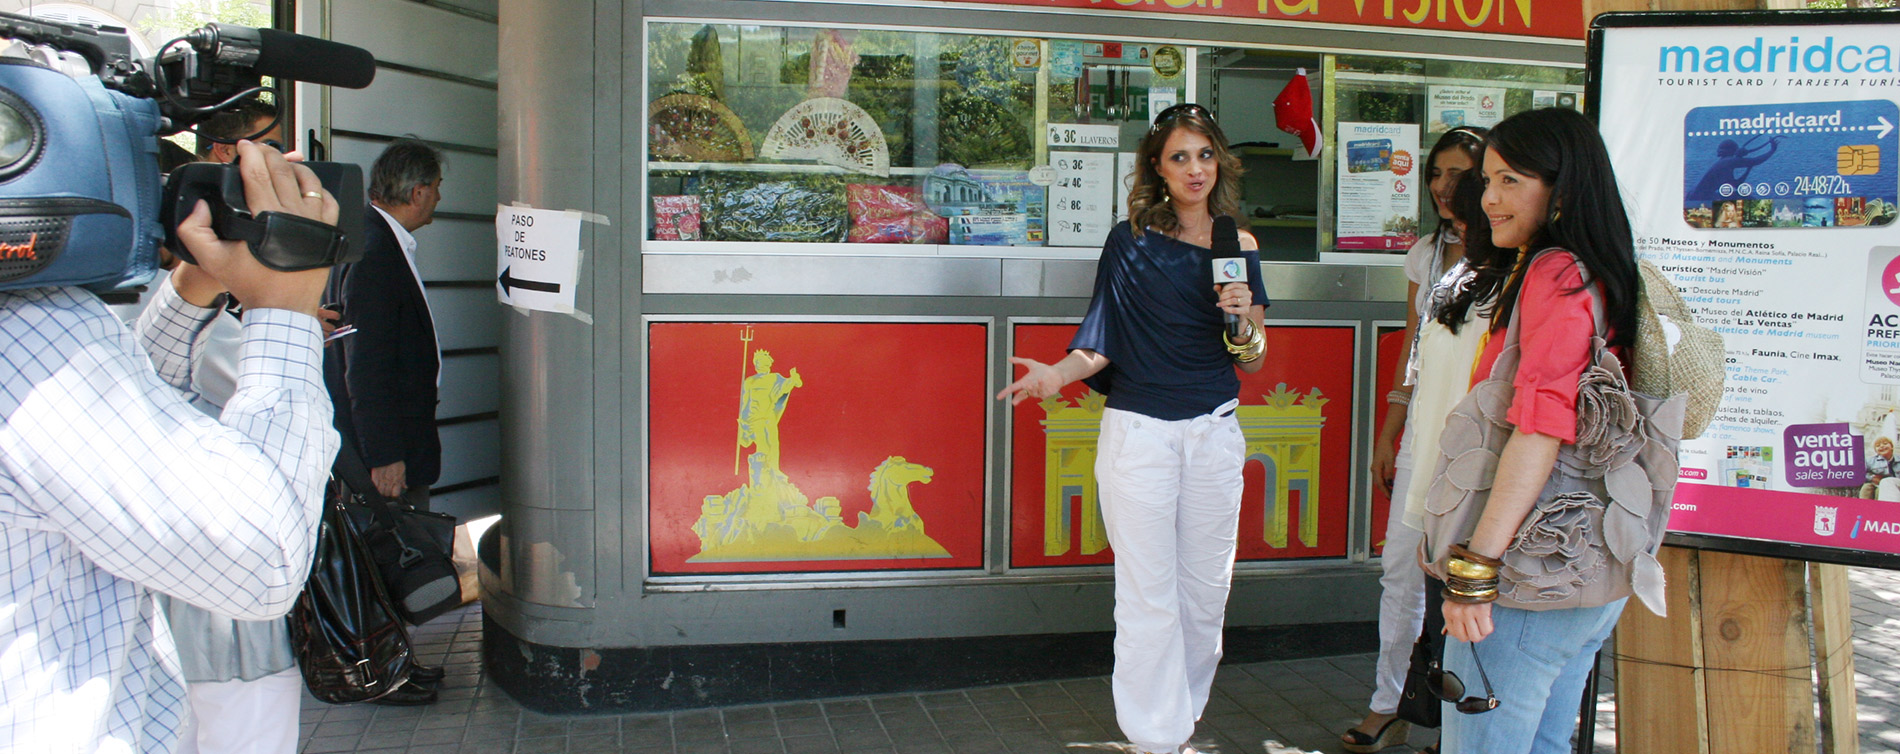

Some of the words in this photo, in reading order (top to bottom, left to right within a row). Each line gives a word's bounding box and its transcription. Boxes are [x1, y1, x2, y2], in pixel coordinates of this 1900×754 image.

[1658, 36, 1900, 73] madridca
[1658, 78, 1718, 86] TOURIST
[1726, 78, 1764, 86] CARD
[1787, 79, 1849, 87] TARJETA
[1719, 110, 1842, 130] madridcard
[1354, 125, 1401, 134] madridcard
[1080, 136, 1118, 145] LLAVEROS
[511, 214, 534, 227] PASO
[514, 230, 525, 242] DE
[1649, 237, 1659, 245] 50
[1661, 238, 1698, 246] Museos
[1708, 240, 1775, 249] Monumentos
[504, 245, 546, 261] PEATONES
[1672, 253, 1716, 262] Museums
[1735, 256, 1793, 265] Monuments
[1661, 265, 1704, 273] turístico
[1674, 273, 1706, 282] Tourist
[1709, 275, 1726, 283] bus
[1716, 297, 1742, 305] tours
[1701, 307, 1728, 316] Museo
[1746, 310, 1788, 319] Atlético
[1807, 312, 1844, 322] Madrid
[1696, 315, 1718, 324] Toros
[1721, 317, 1731, 325] de
[1868, 313, 1900, 328] AC
[1766, 329, 1804, 338] Madrid
[1805, 332, 1840, 340] museum
[1751, 348, 1788, 358] Faunia,
[1790, 351, 1810, 359] Cine
[1724, 365, 1741, 373] nia
[1744, 366, 1769, 374] Theme
[1732, 373, 1758, 382] Cable
[1750, 386, 1768, 395] vino
[1735, 395, 1752, 403] wine
[1717, 406, 1751, 415] usicales,
[1712, 414, 1737, 423] oches
[1739, 415, 1748, 423] de
[1720, 423, 1751, 432] flamenco
[1793, 431, 1853, 448] venta
[1794, 447, 1854, 470] aquí
[1795, 469, 1824, 480] sales
[1827, 468, 1855, 480] here
